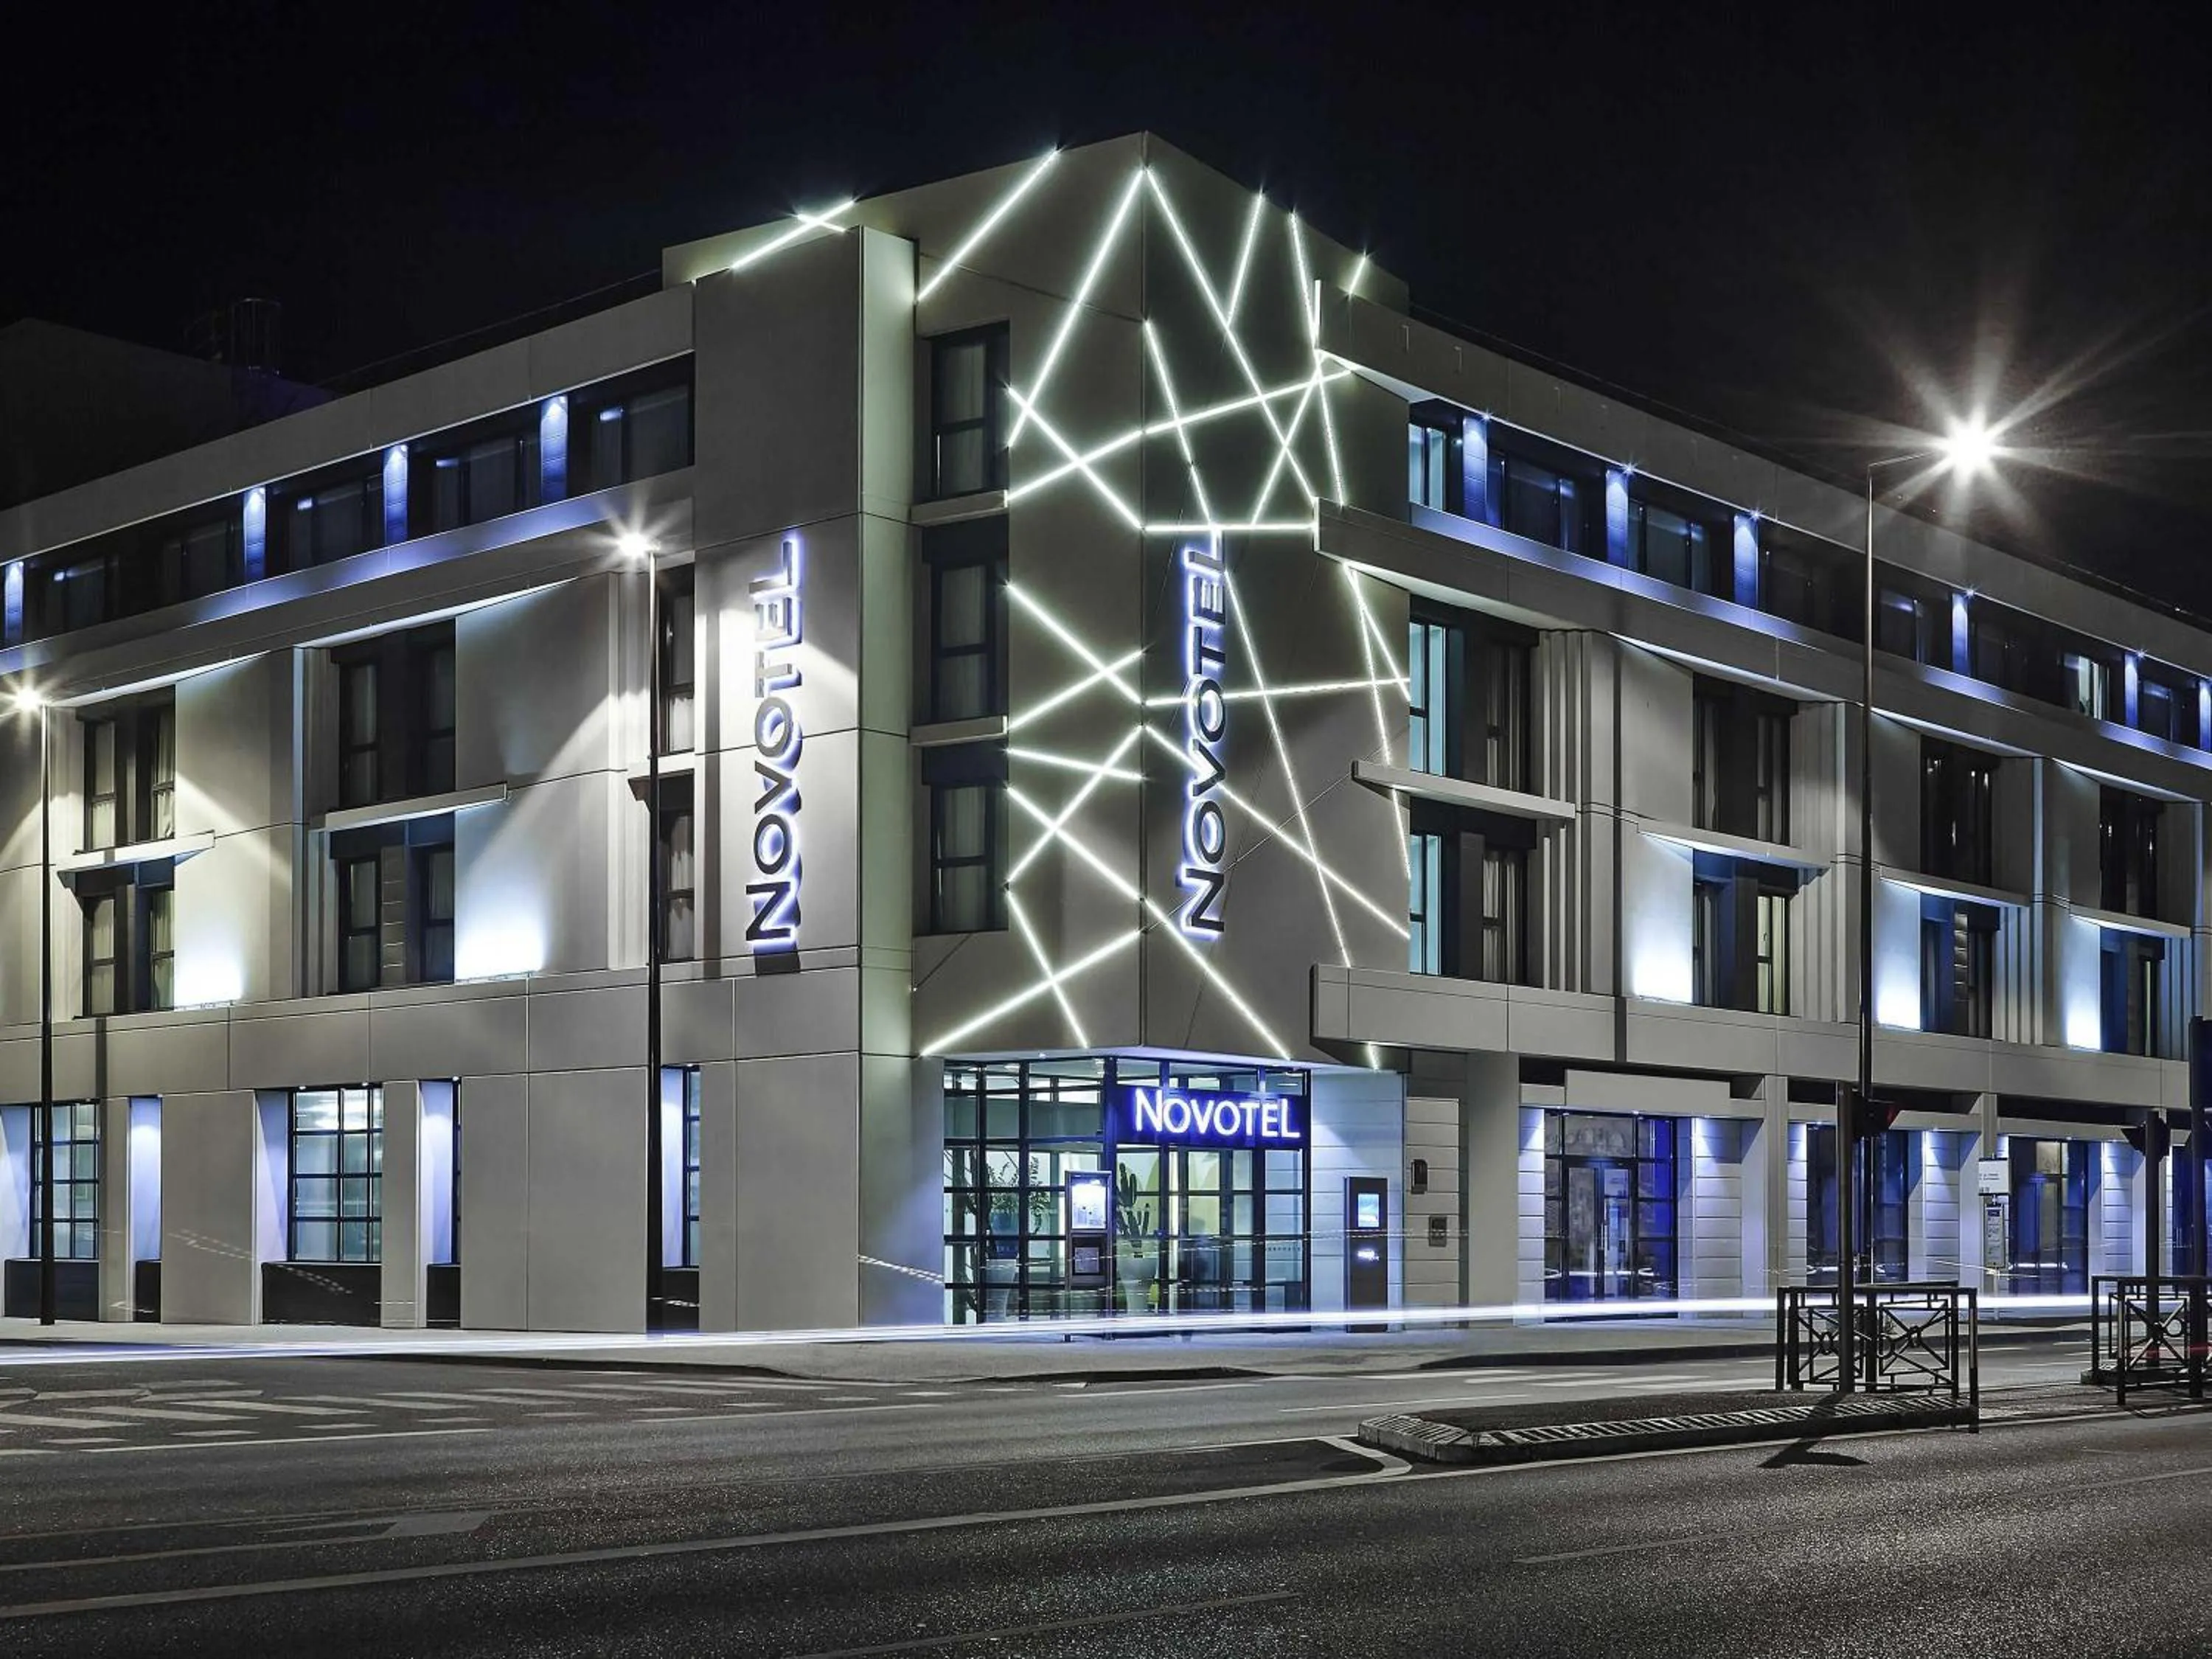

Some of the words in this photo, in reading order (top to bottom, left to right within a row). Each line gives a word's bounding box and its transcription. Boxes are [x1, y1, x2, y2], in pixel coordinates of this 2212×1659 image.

[745, 539, 799, 944] NOVOTEL
[1183, 524, 1227, 933] NOVOTEL
[1135, 1088, 1301, 1138] NOVOTEL
